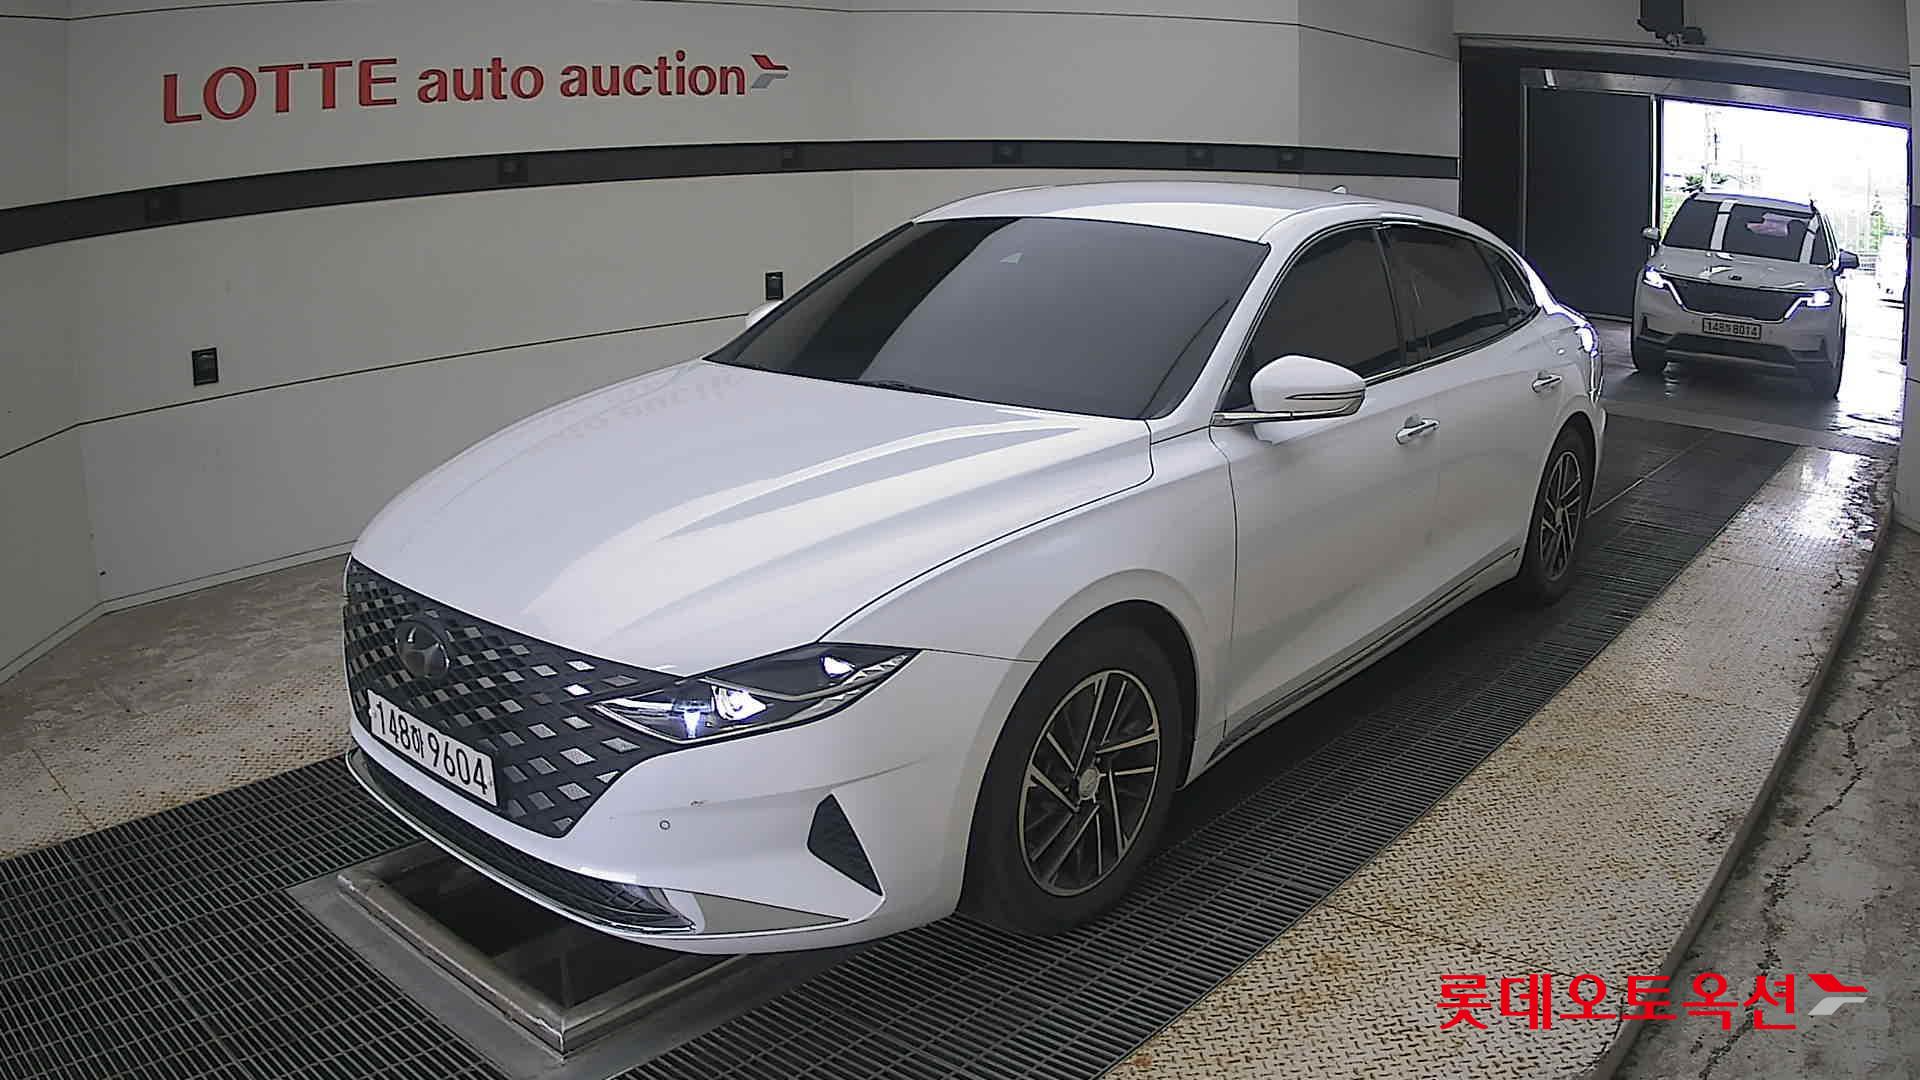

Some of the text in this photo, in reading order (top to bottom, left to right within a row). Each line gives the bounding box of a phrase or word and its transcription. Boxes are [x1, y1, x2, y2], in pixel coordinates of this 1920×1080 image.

[162, 50, 746, 125] LOTTE auto auction
